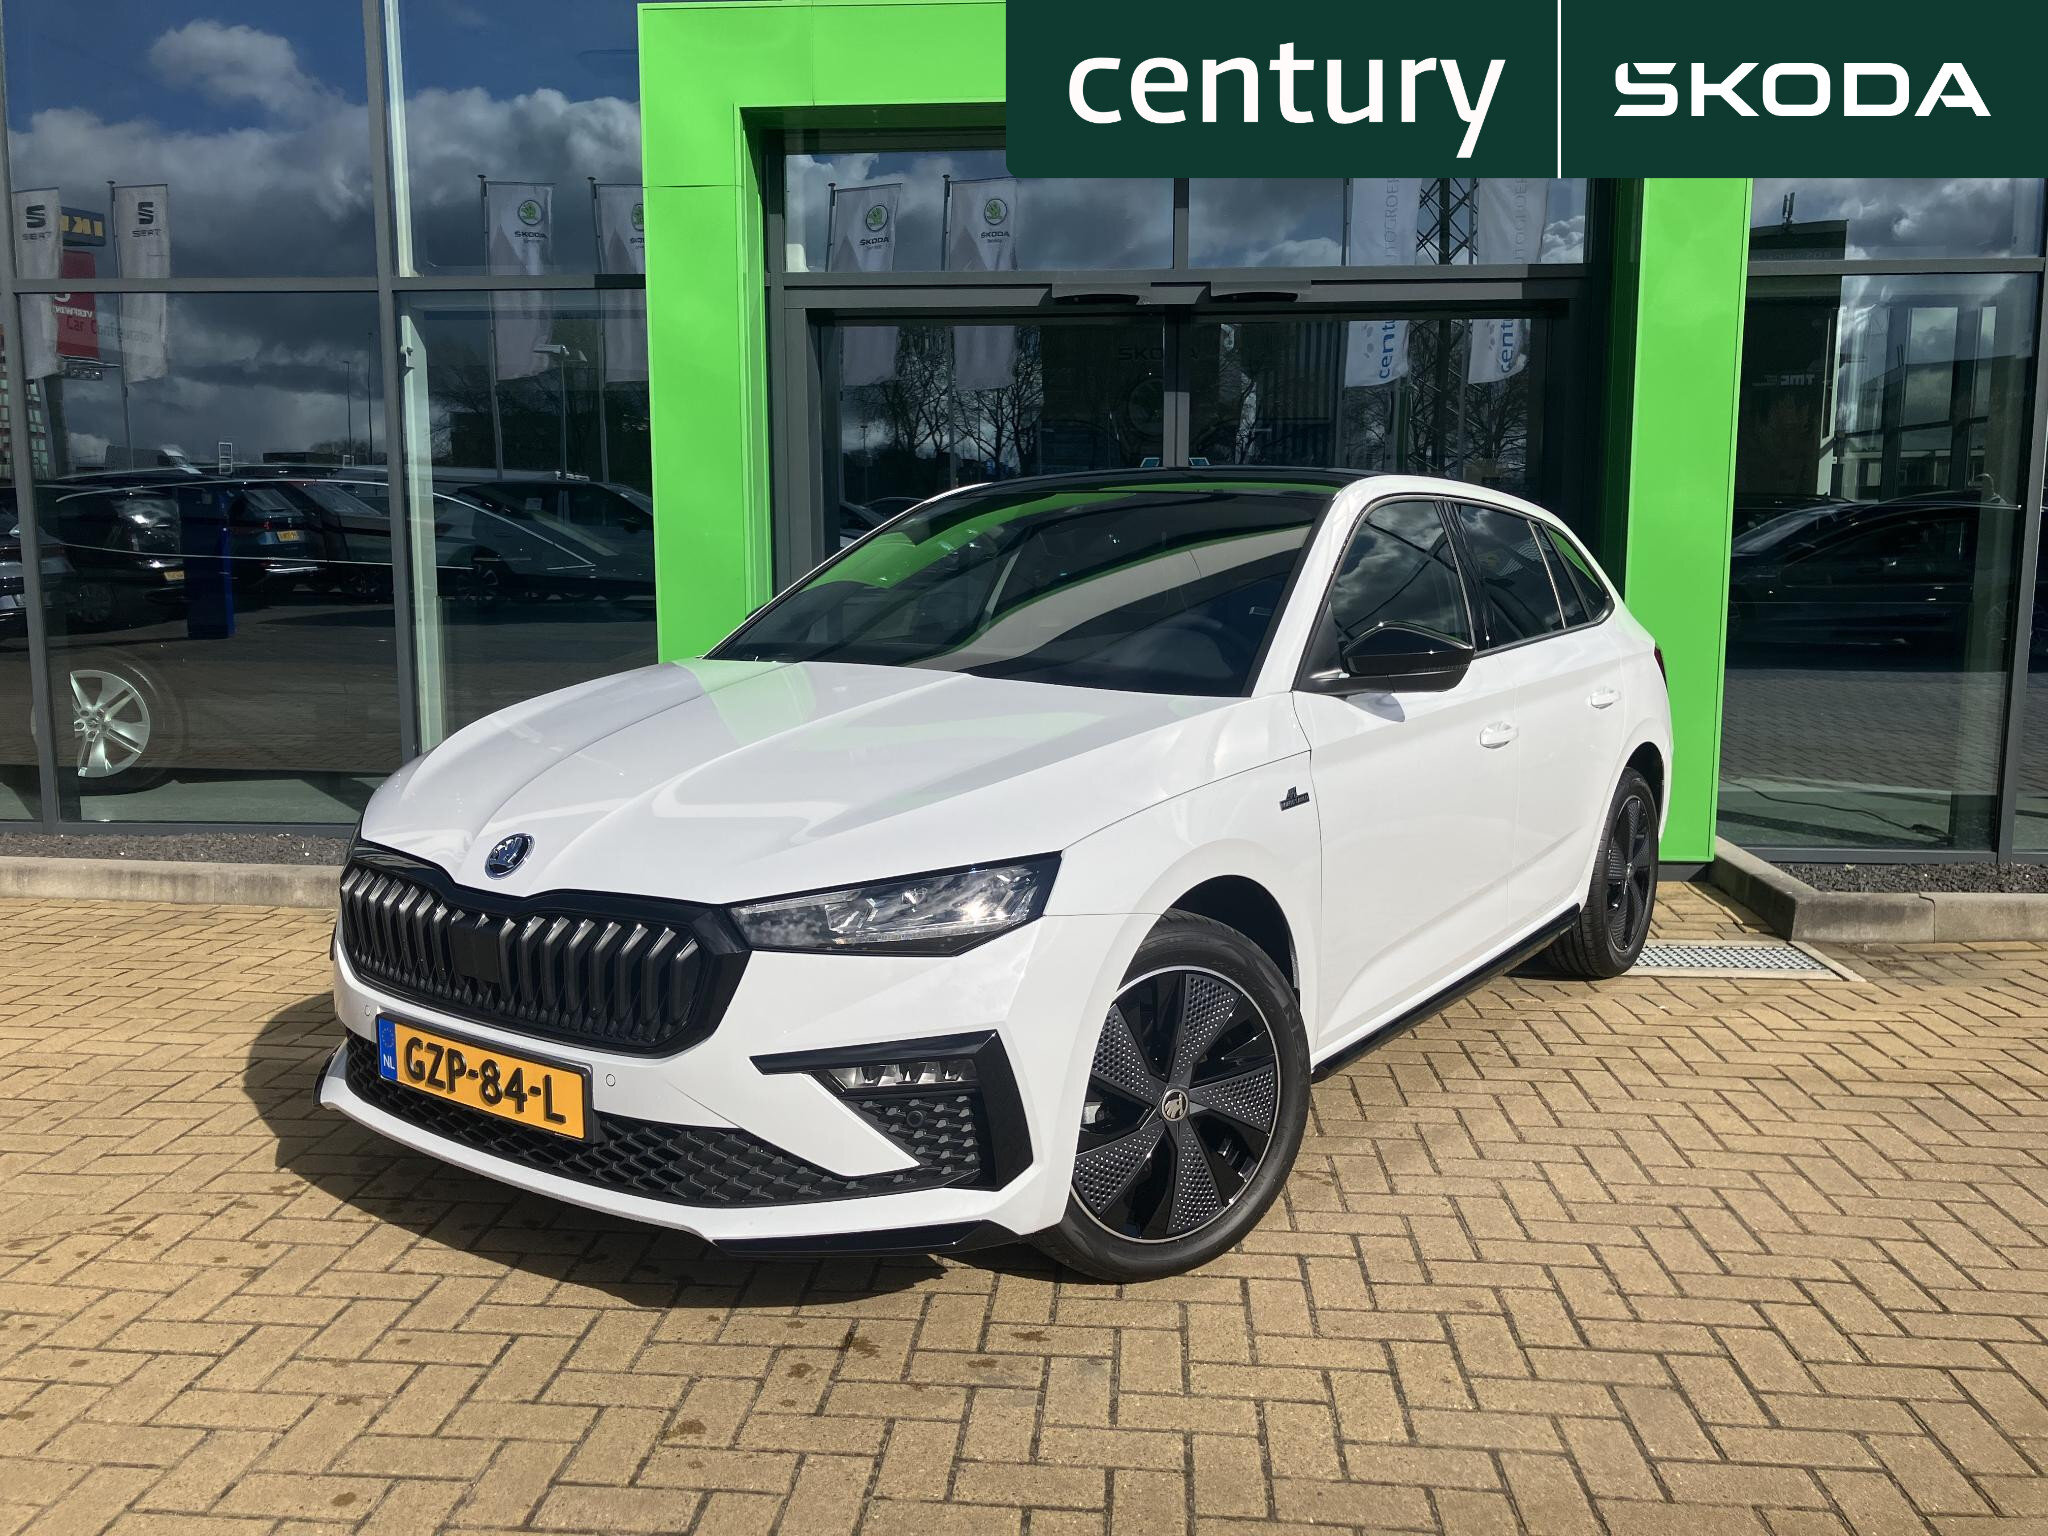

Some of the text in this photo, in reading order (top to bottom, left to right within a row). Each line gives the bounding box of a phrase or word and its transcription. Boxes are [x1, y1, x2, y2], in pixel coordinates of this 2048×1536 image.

[22, 231, 51, 240] SEAT
[132, 229, 162, 238] SEAT
[66, 315, 85, 332] Car
[1500, 318, 1514, 373] cent
[383, 1036, 566, 1125] NL GZP-84-L
